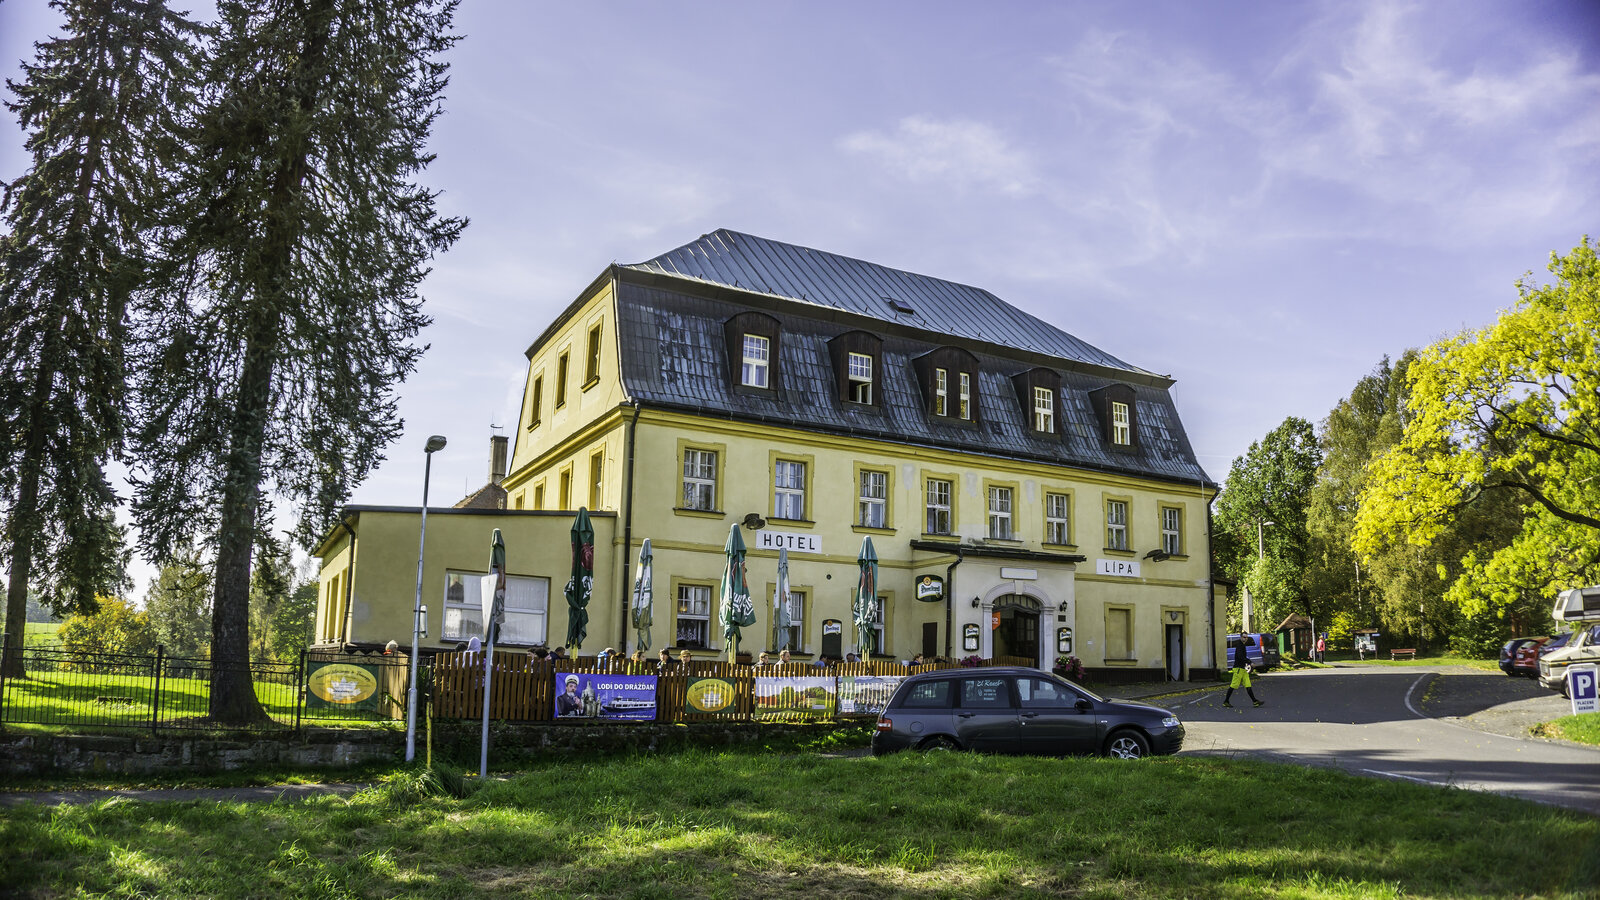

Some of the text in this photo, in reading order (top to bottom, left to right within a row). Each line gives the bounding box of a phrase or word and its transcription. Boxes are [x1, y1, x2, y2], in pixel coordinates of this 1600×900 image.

[763, 533, 816, 550] HOTEL
[1105, 561, 1133, 575] LÍPA
[597, 682, 613, 690] LODÍ
[1577, 675, 1592, 696] P
